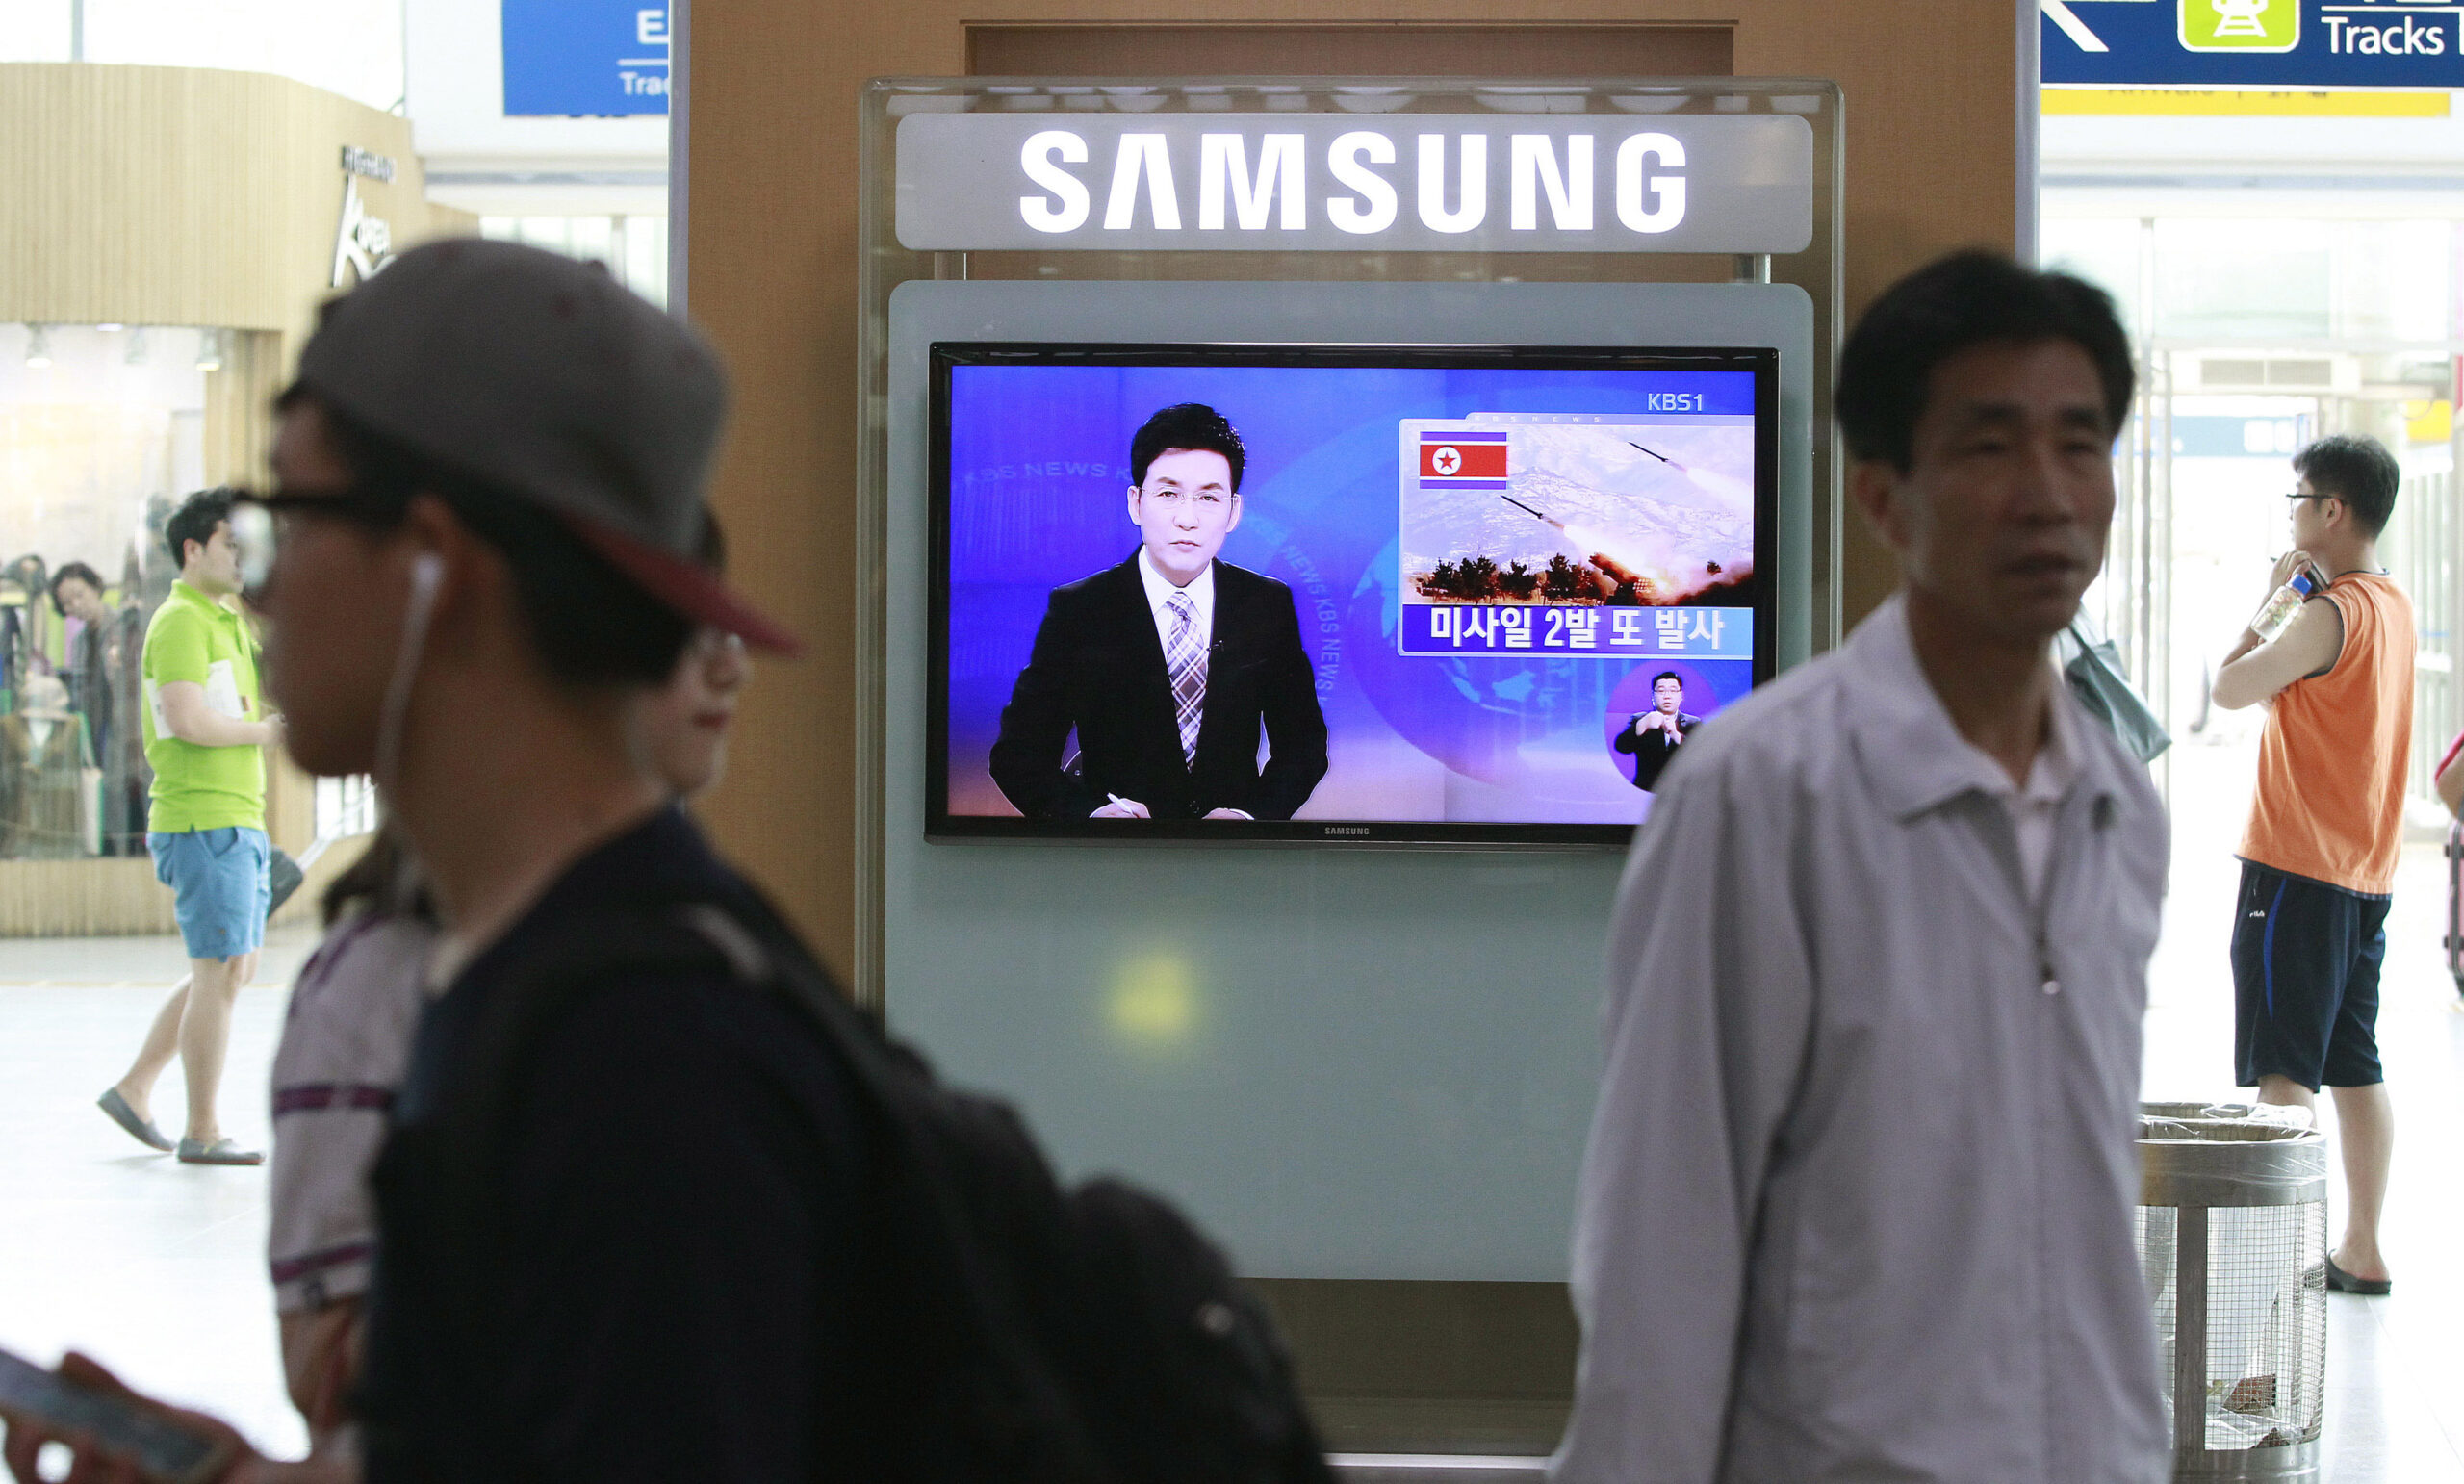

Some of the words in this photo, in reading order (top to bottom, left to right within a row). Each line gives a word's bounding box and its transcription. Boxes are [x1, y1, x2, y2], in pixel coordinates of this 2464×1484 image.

[2321, 15, 2445, 55] Tracks
[1019, 130, 1687, 234] SAMSUNG
[1647, 393, 1703, 412] KBS1
[1430, 606, 1533, 649] 미사일
[1543, 608, 1601, 650] 2발
[1608, 609, 1644, 646] 또
[1654, 609, 1726, 651] 발사
[1317, 638, 1341, 691] NEWS
[1324, 827, 1370, 835] SAMSUNG
